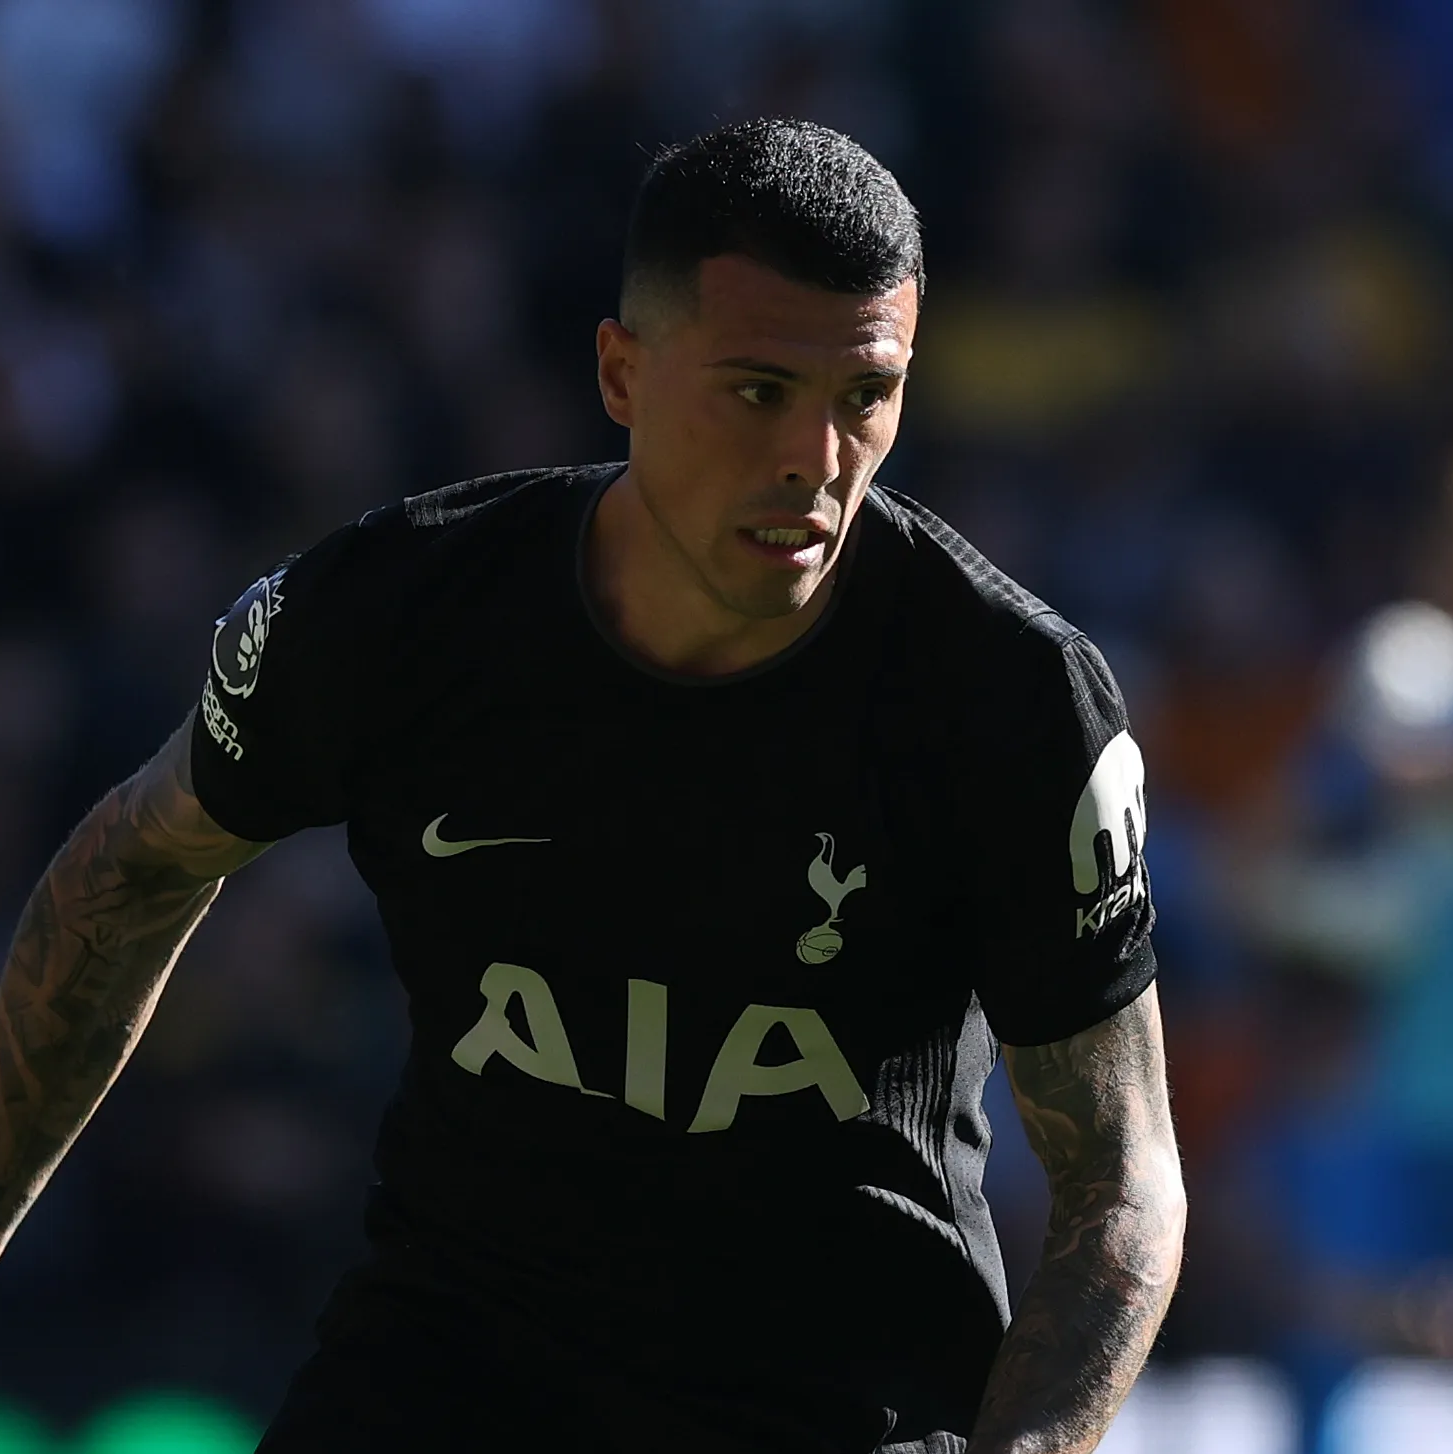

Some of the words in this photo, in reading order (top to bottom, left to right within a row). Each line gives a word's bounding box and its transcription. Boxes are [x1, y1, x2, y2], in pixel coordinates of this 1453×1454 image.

[202, 684, 244, 761] acism
[206, 668, 239, 740] oom
[450, 961, 871, 1135] AIA
